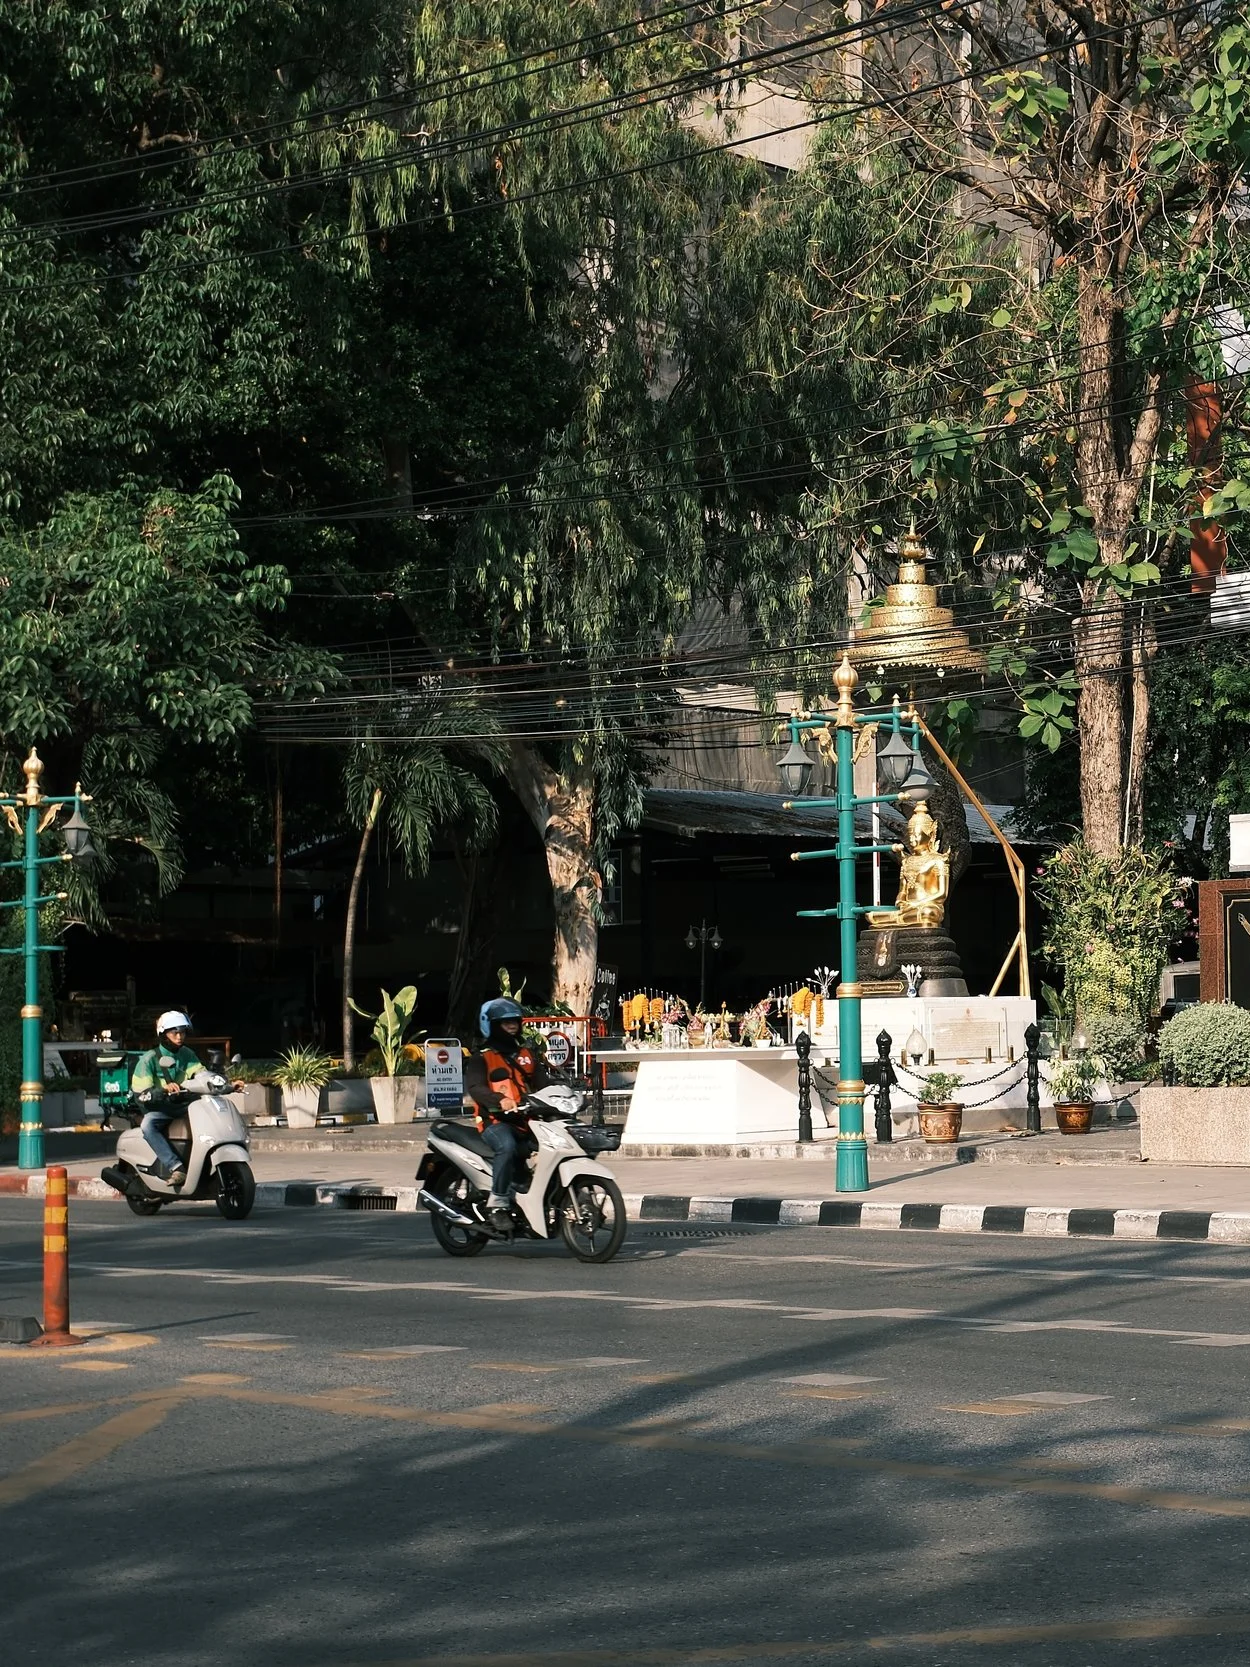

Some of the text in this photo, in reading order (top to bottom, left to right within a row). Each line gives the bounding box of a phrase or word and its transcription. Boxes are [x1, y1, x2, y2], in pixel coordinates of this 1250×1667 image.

[597, 968, 616, 985] Coffee
[517, 1057, 532, 1065] 24
[431, 1064, 458, 1074] ห้ามเข้า
